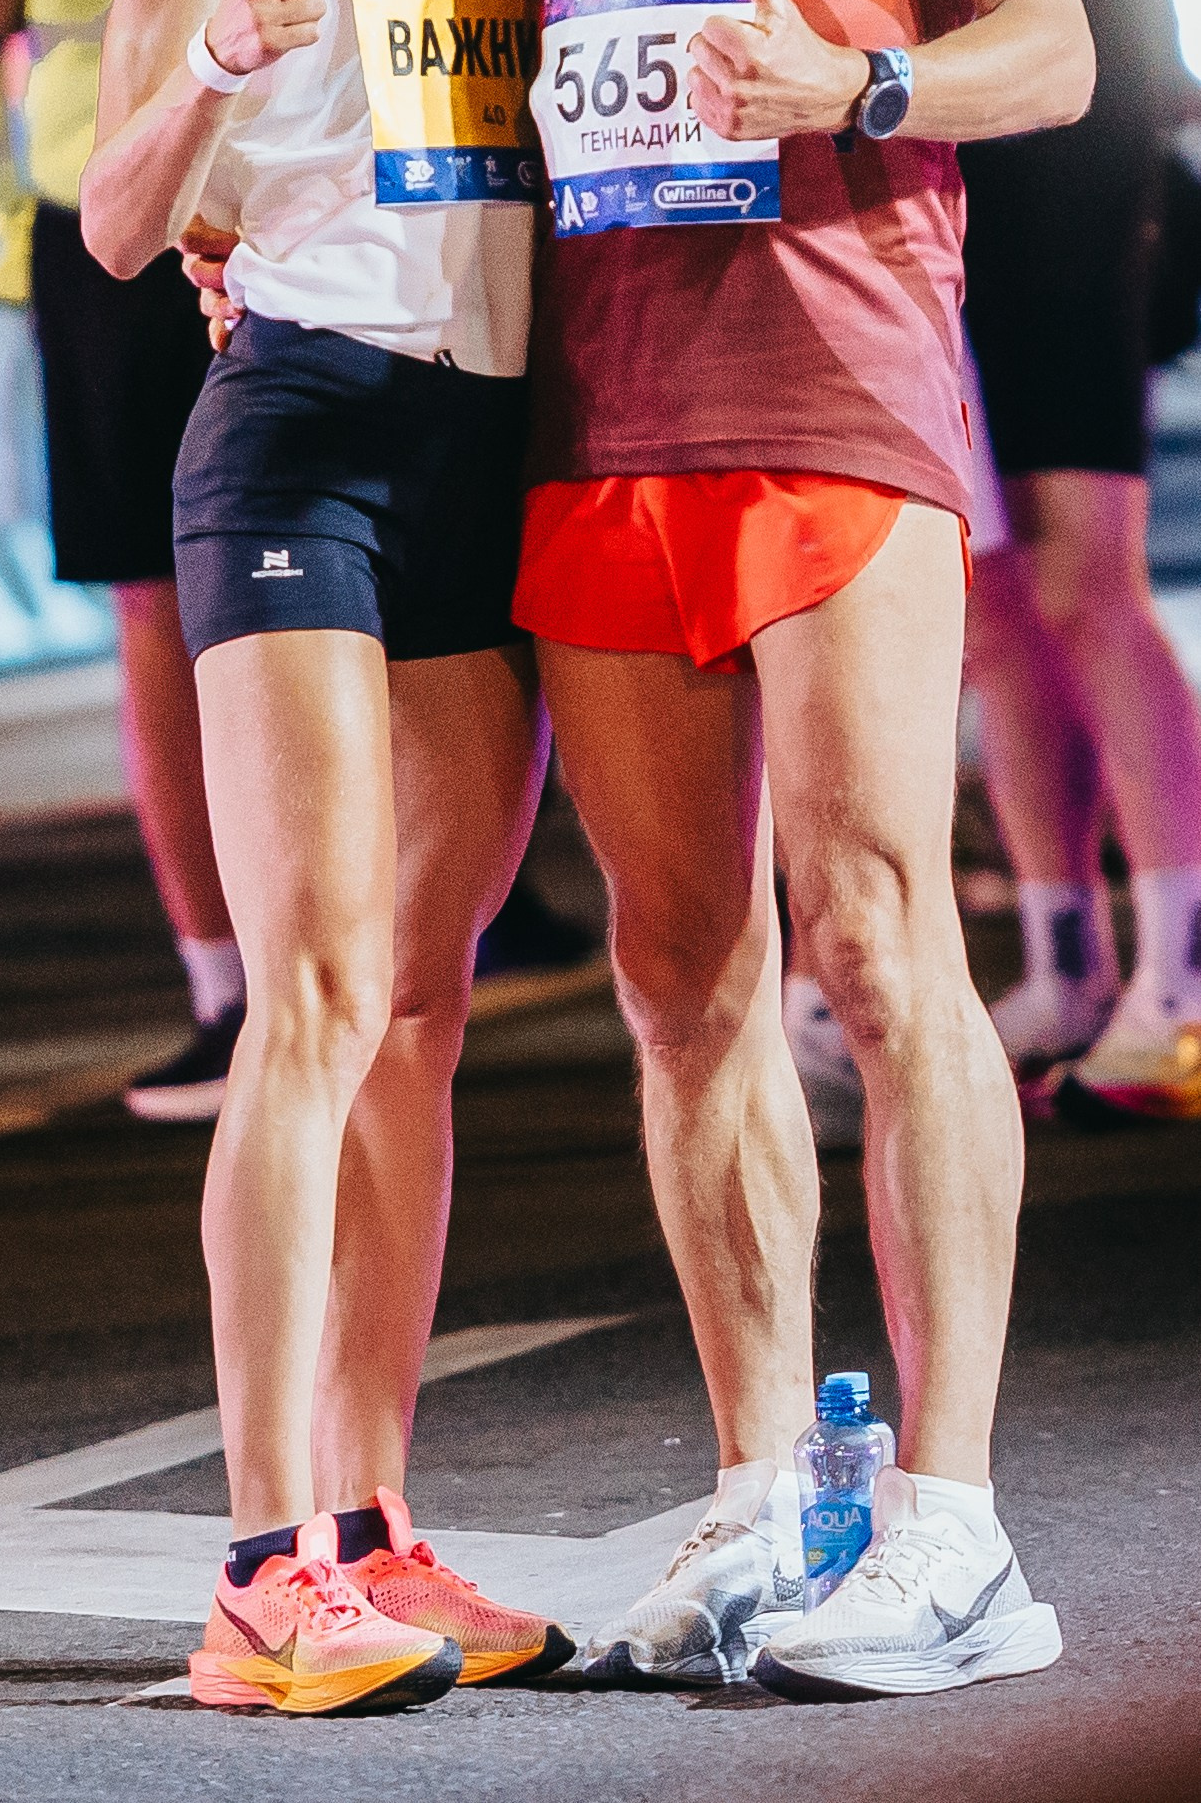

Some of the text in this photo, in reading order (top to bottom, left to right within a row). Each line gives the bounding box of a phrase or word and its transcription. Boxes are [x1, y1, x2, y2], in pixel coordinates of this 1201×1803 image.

[554, 31, 695, 123] 565
[581, 117, 701, 153] ГЕННАДИЙ
[662, 185, 727, 202] Winline
[807, 1506, 862, 1529] AQUA
